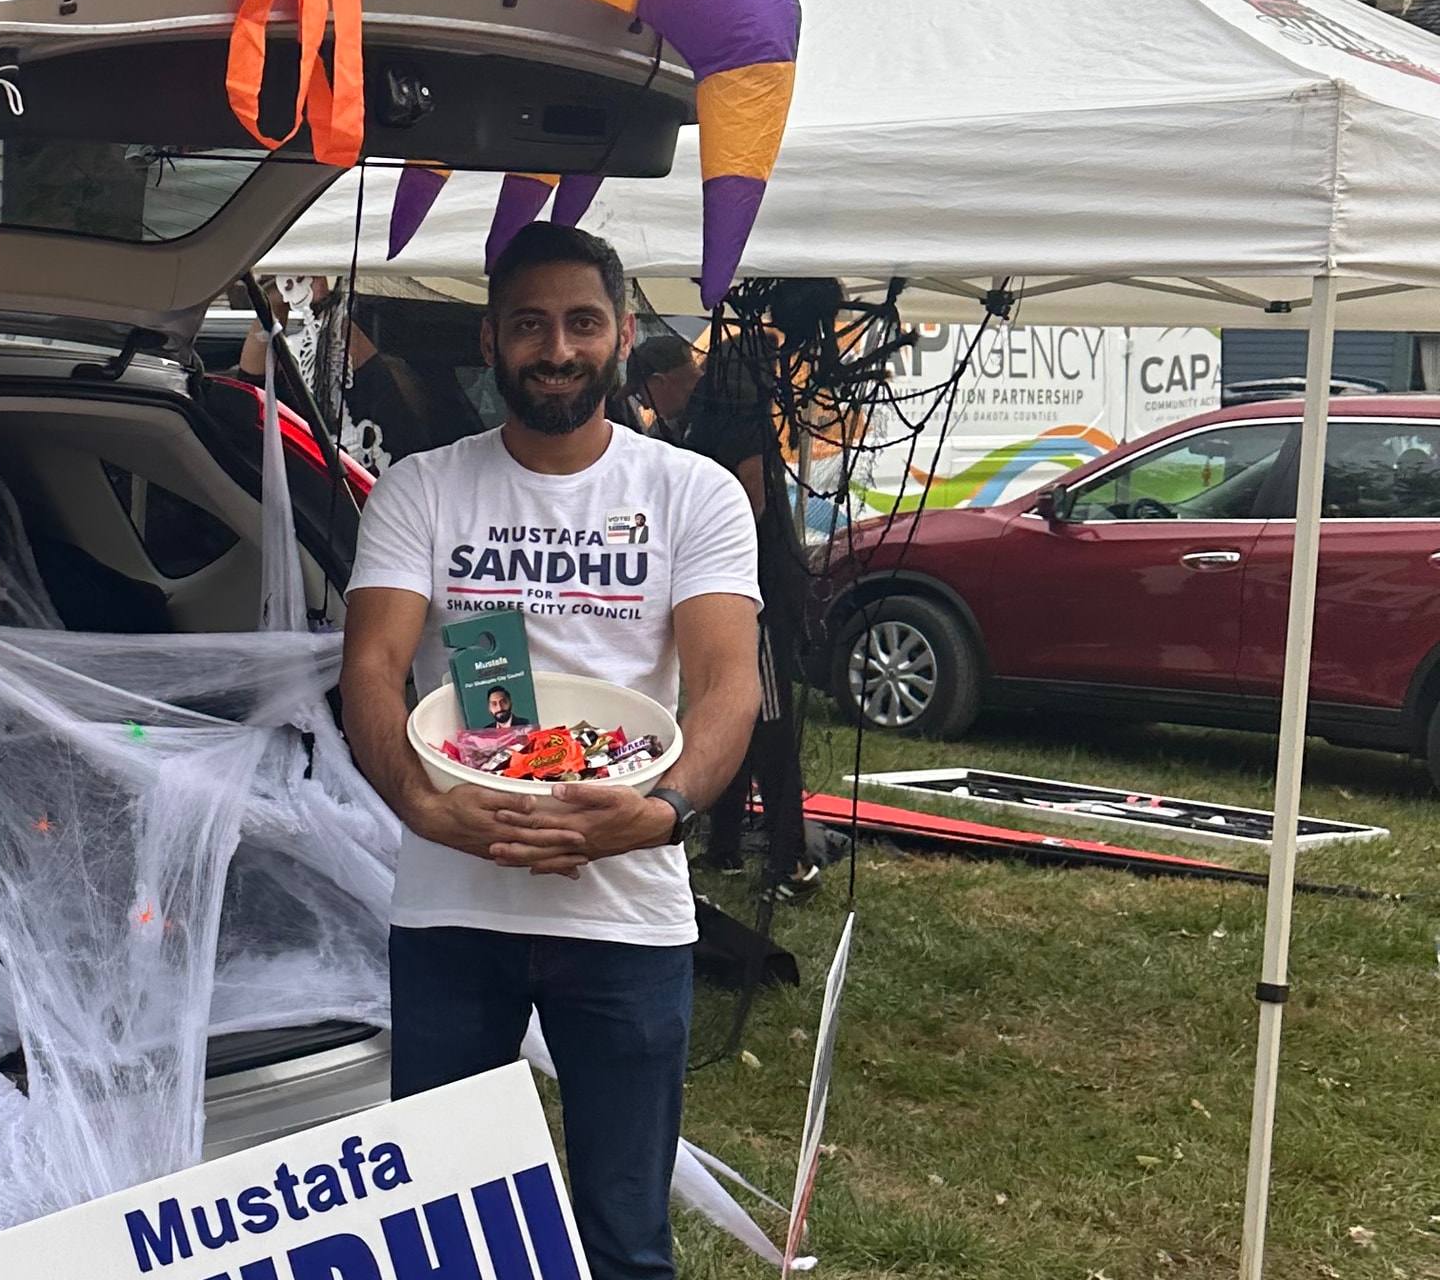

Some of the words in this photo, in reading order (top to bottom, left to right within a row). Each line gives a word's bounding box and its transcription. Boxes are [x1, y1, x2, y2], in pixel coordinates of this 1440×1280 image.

[953, 326, 1105, 380] AGENCY
[1140, 353, 1211, 395] CAP
[992, 388, 1084, 406] PARTNERSHIP
[1144, 396, 1198, 412] COMMUNITY
[973, 411, 1009, 422] DAKOTA
[1014, 410, 1058, 422] COUNTIES
[488, 526, 604, 547] MUSTAFA
[448, 544, 648, 586] SANDHU
[527, 588, 553, 600] FOR
[530, 603, 566, 615] CITY
[571, 604, 642, 620] COUNCIL
[125, 1135, 413, 1273] Mustafa
